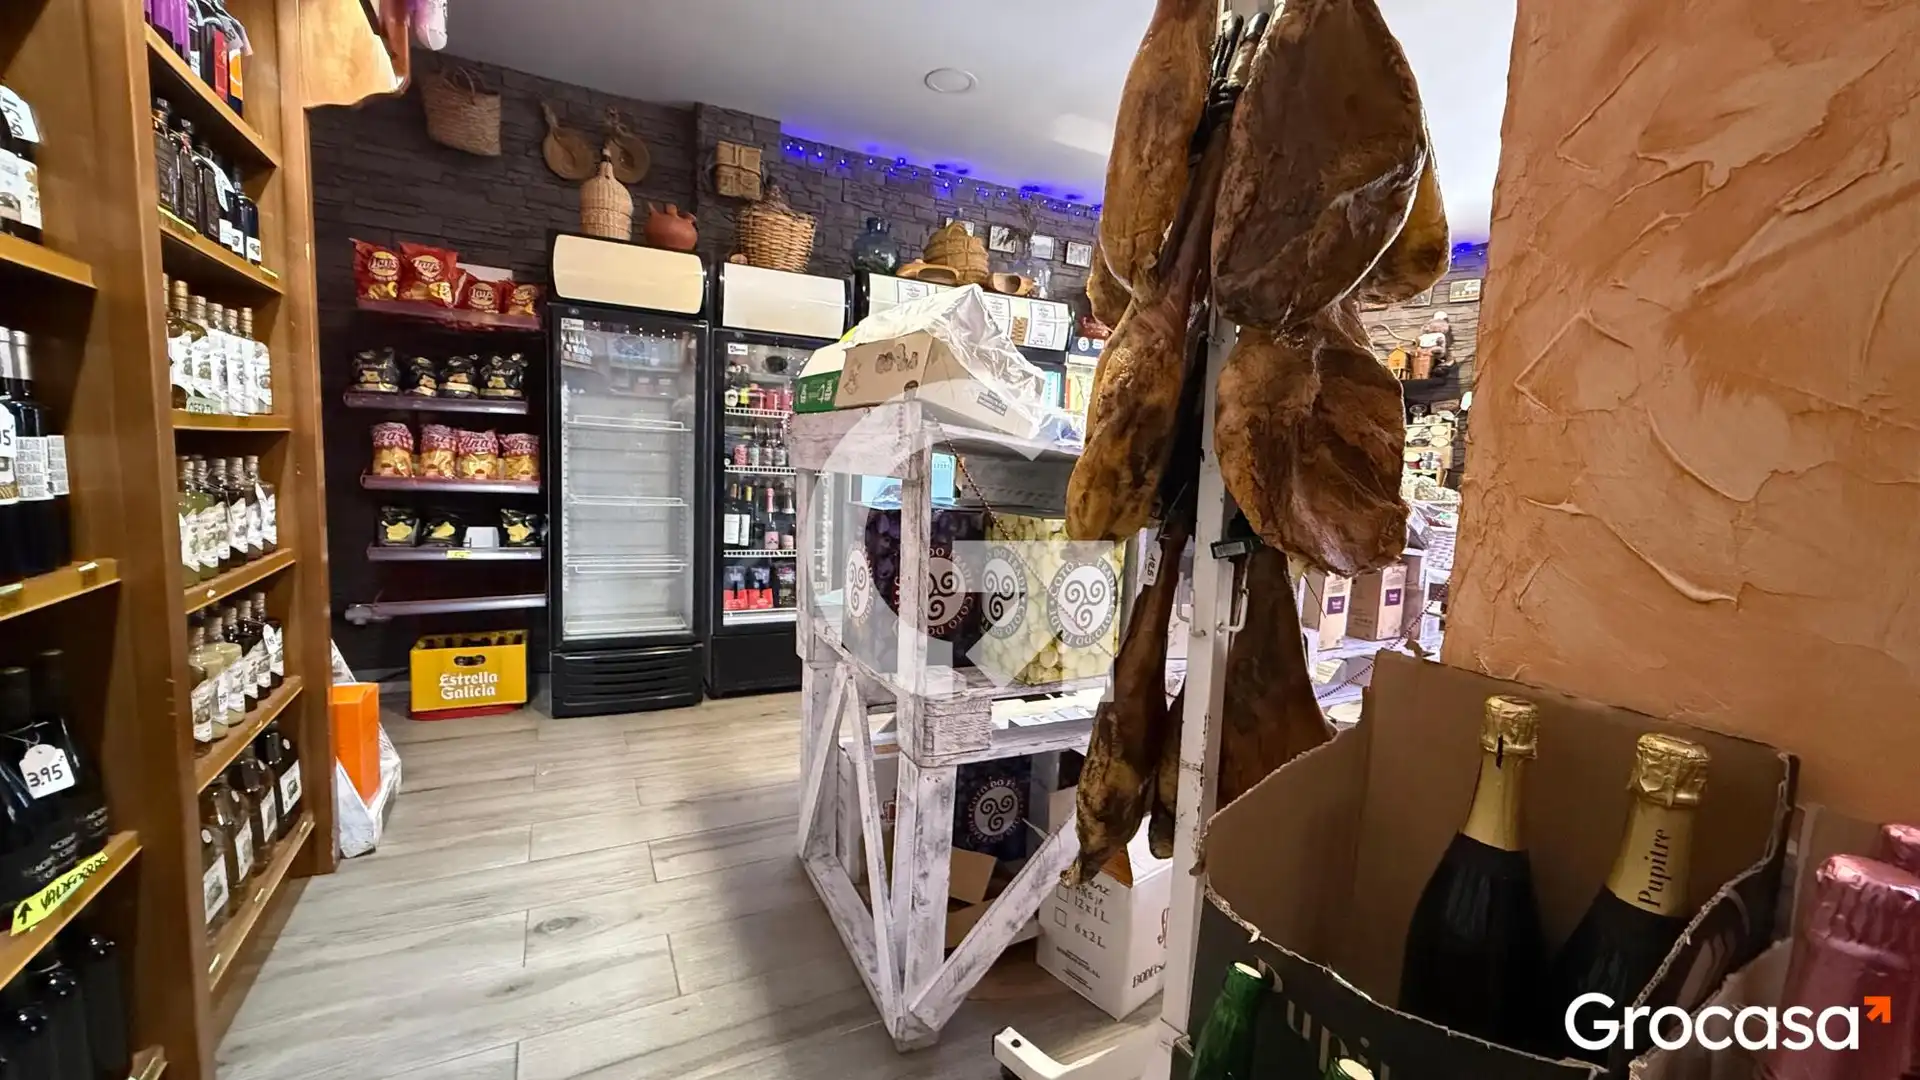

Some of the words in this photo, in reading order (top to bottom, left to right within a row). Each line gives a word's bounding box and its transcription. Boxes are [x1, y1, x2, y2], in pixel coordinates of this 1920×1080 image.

[1048, 560, 1076, 598] COTO
[439, 671, 499, 687] Estrella
[441, 684, 496, 700] Galicia
[1637, 828, 1672, 908] Pupitre
